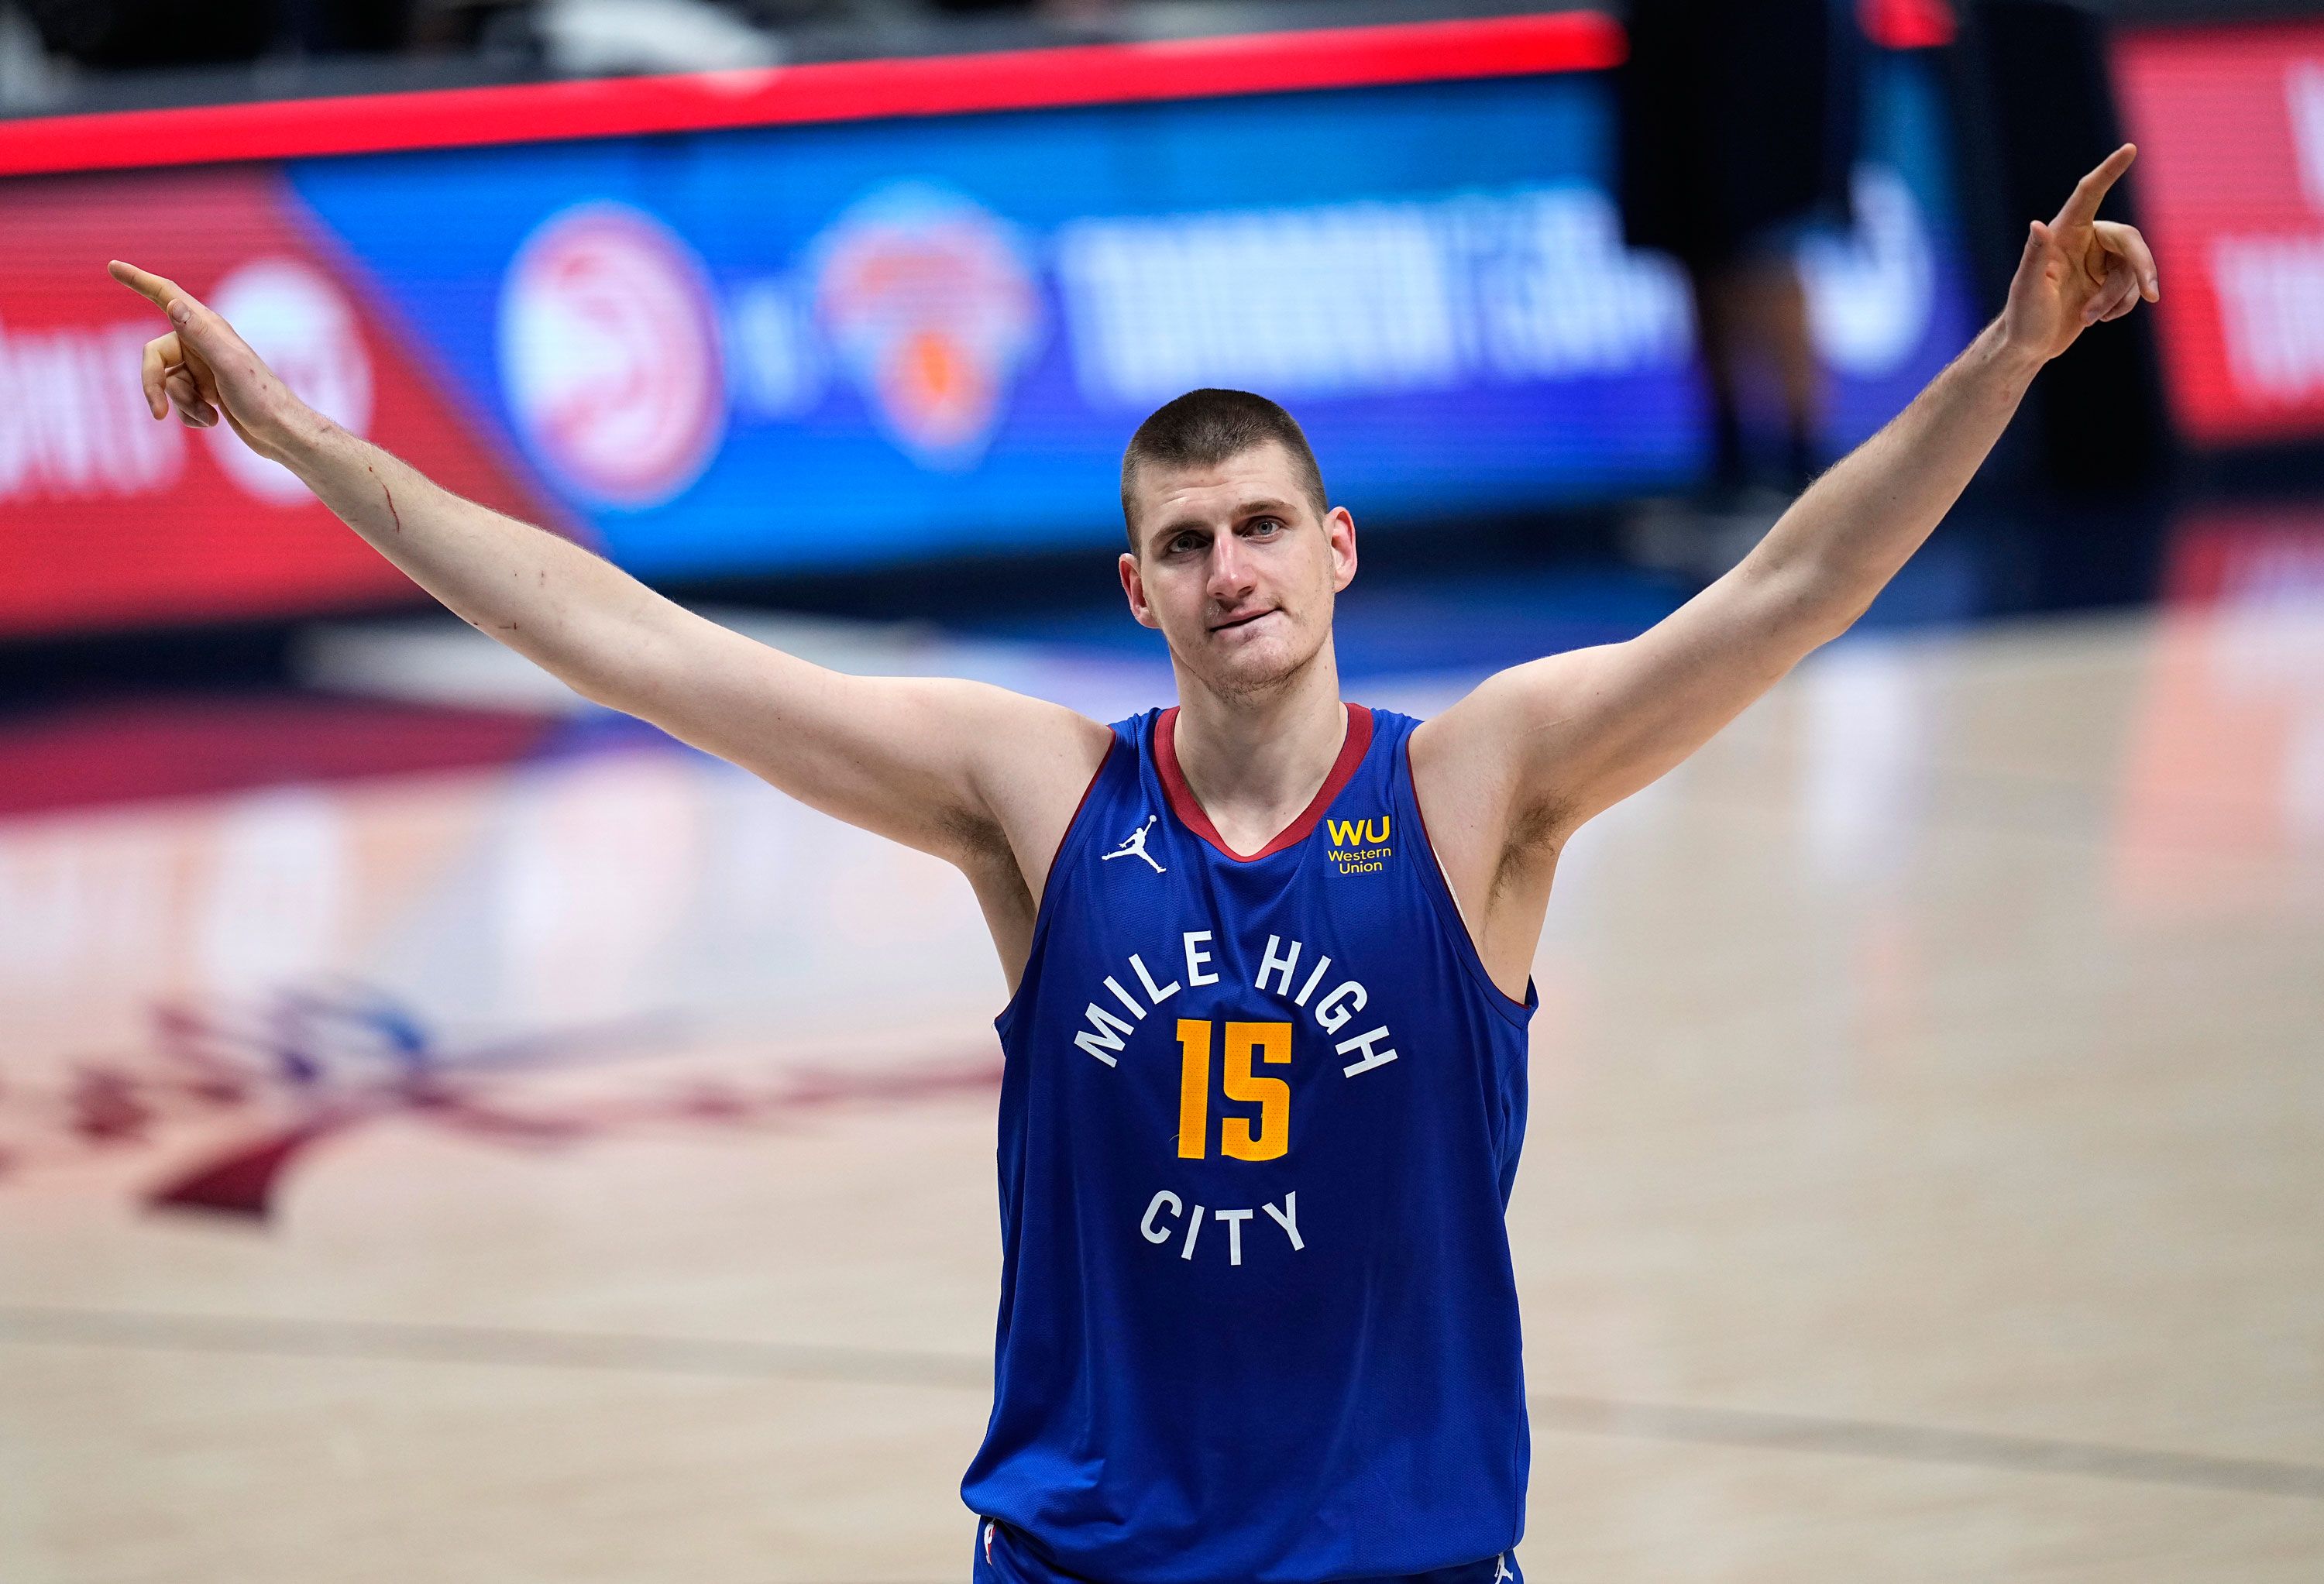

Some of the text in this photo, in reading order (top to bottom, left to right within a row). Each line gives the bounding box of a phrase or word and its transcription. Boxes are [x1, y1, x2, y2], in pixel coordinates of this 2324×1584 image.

[1326, 815, 1391, 847] WU
[1327, 847, 1391, 862] Western
[1339, 861, 1383, 874] Union
[1074, 929, 1398, 1078] MILE HIGH
[1176, 1019, 1292, 1162] 15
[1140, 1190, 1305, 1266] CITY
